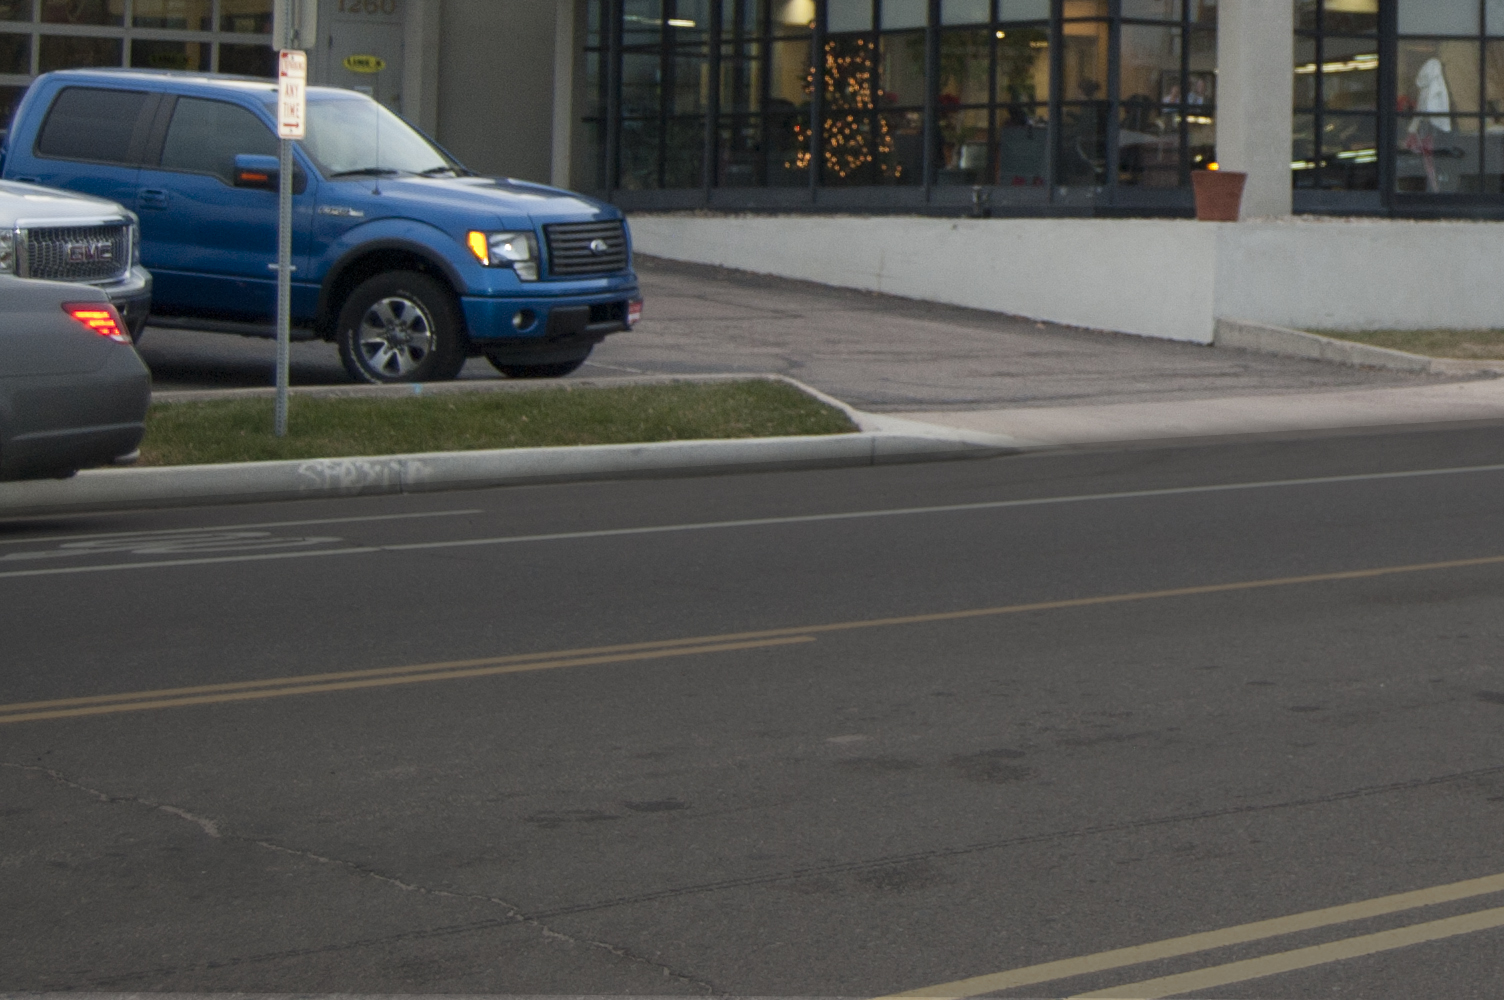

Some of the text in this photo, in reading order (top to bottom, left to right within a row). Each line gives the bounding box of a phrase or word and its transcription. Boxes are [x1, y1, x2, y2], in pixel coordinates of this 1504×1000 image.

[285, 83, 298, 97] ANY
[283, 102, 300, 118] TIME
[67, 242, 112, 262] GMC
